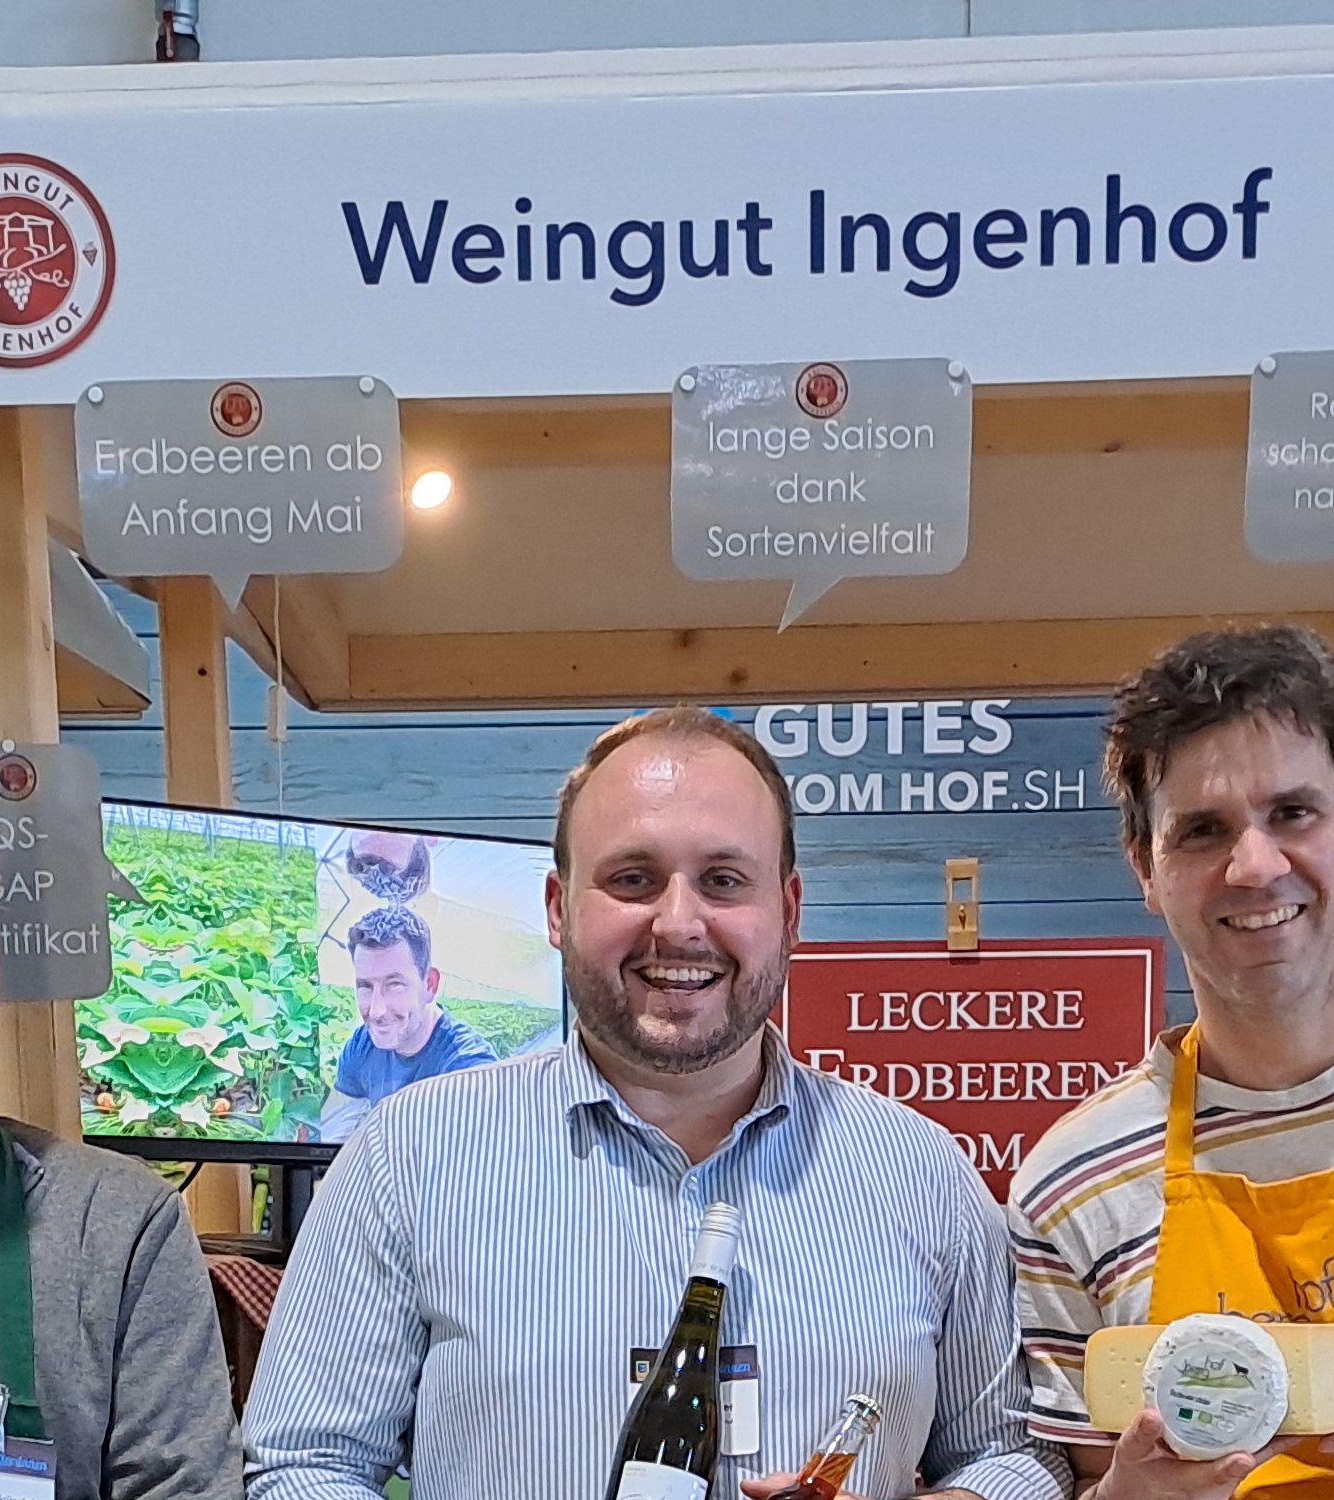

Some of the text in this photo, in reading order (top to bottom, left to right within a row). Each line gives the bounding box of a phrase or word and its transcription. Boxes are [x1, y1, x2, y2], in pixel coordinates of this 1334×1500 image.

[340, 167, 1274, 307] Weingut Ingenhof
[94, 435, 384, 476] Erdbeeren ab
[707, 419, 935, 461] lange Saison
[775, 472, 867, 504] dank
[121, 495, 363, 545] Anfang Mai
[705, 522, 936, 559] Sortenvielfalt
[754, 699, 1013, 758] GUTES
[900, 768, 1085, 813] HOF.SH
[846, 989, 1085, 1032] LECKERE
